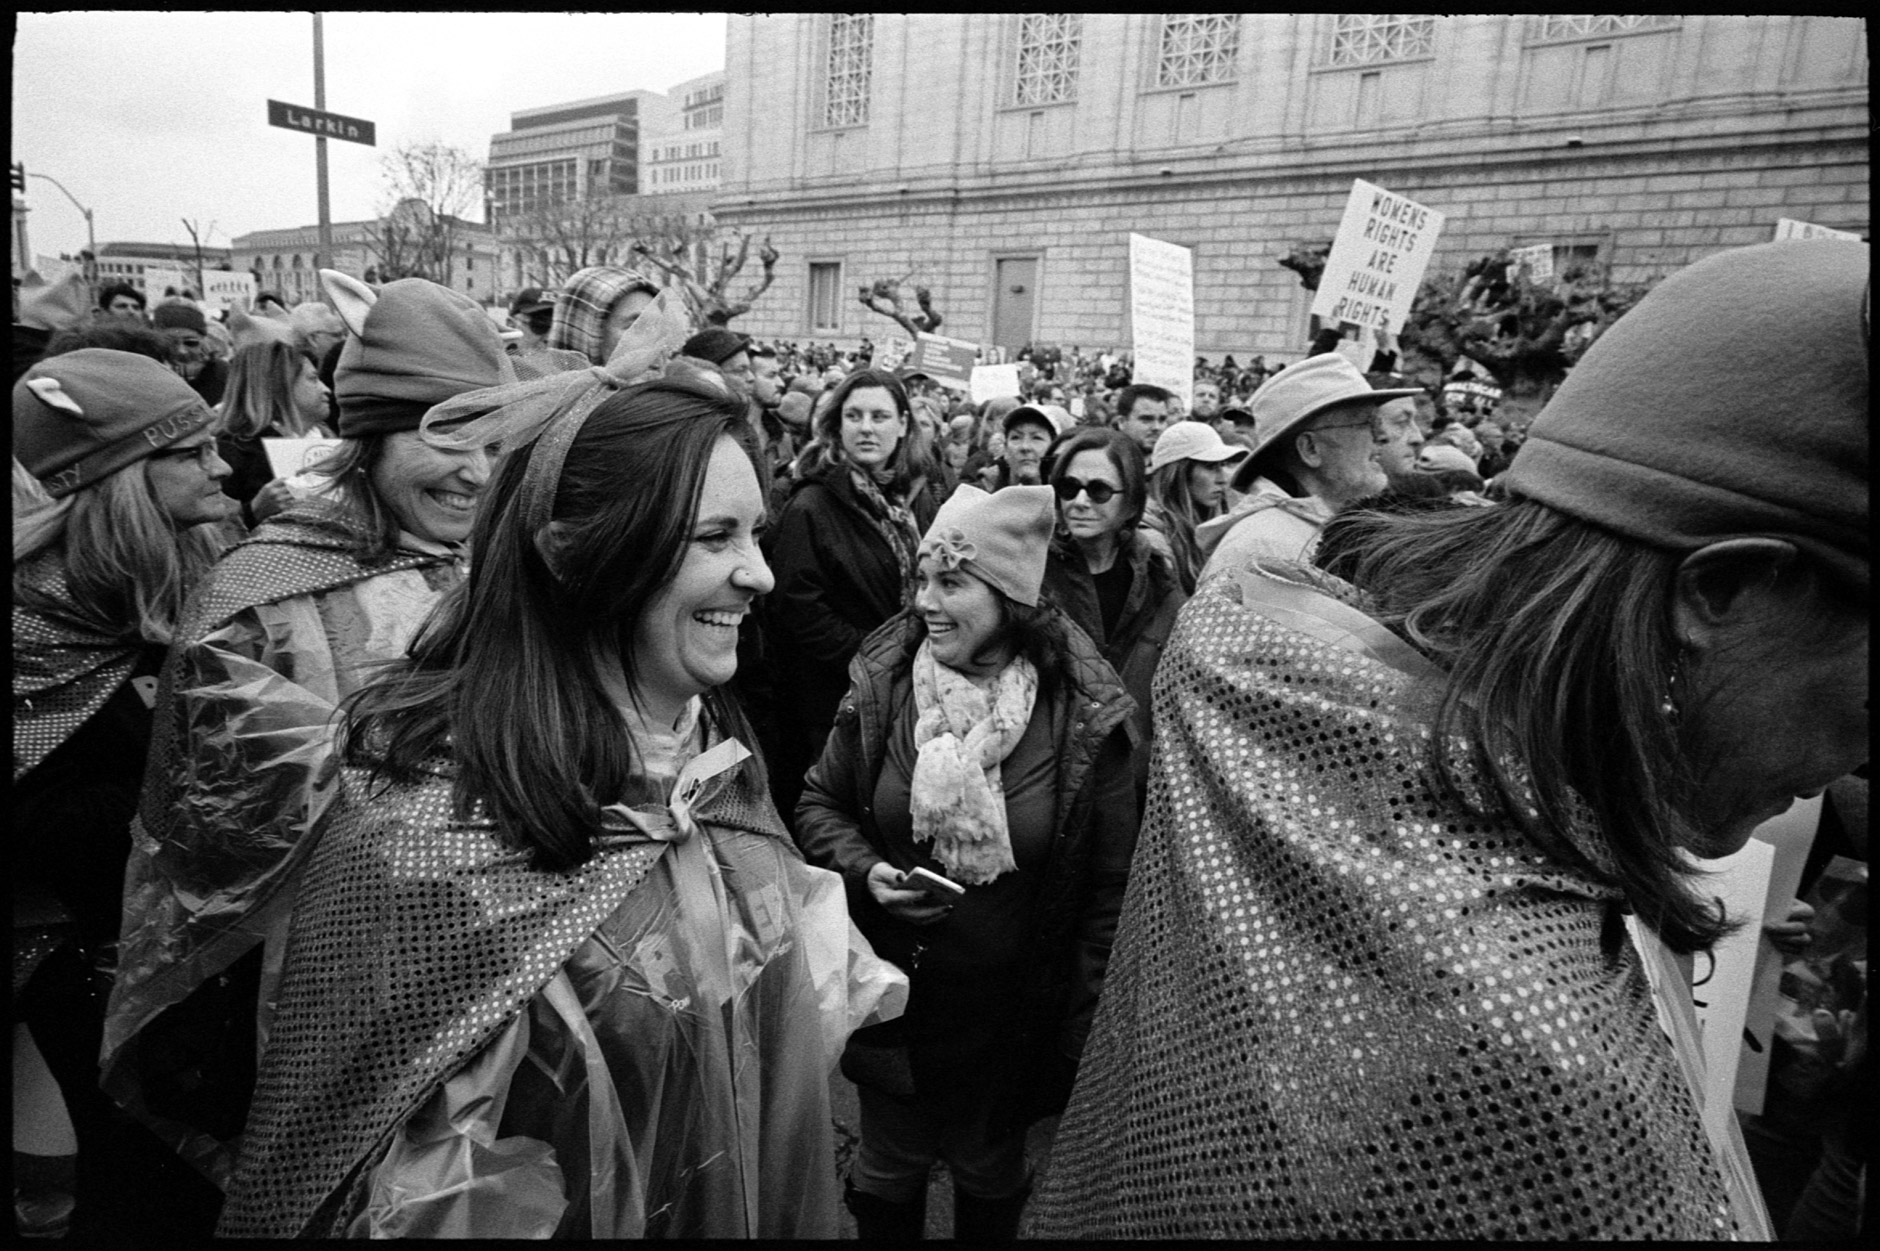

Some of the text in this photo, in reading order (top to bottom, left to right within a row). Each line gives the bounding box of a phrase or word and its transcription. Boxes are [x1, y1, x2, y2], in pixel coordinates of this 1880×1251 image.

[287, 109, 359, 138] Larkin
[1371, 191, 1428, 231] WOMENS
[1363, 217, 1418, 252] RIGHTS
[1366, 248, 1398, 274] ARE
[1347, 270, 1398, 301] HUMAN
[1337, 296, 1391, 328] RIGHTS
